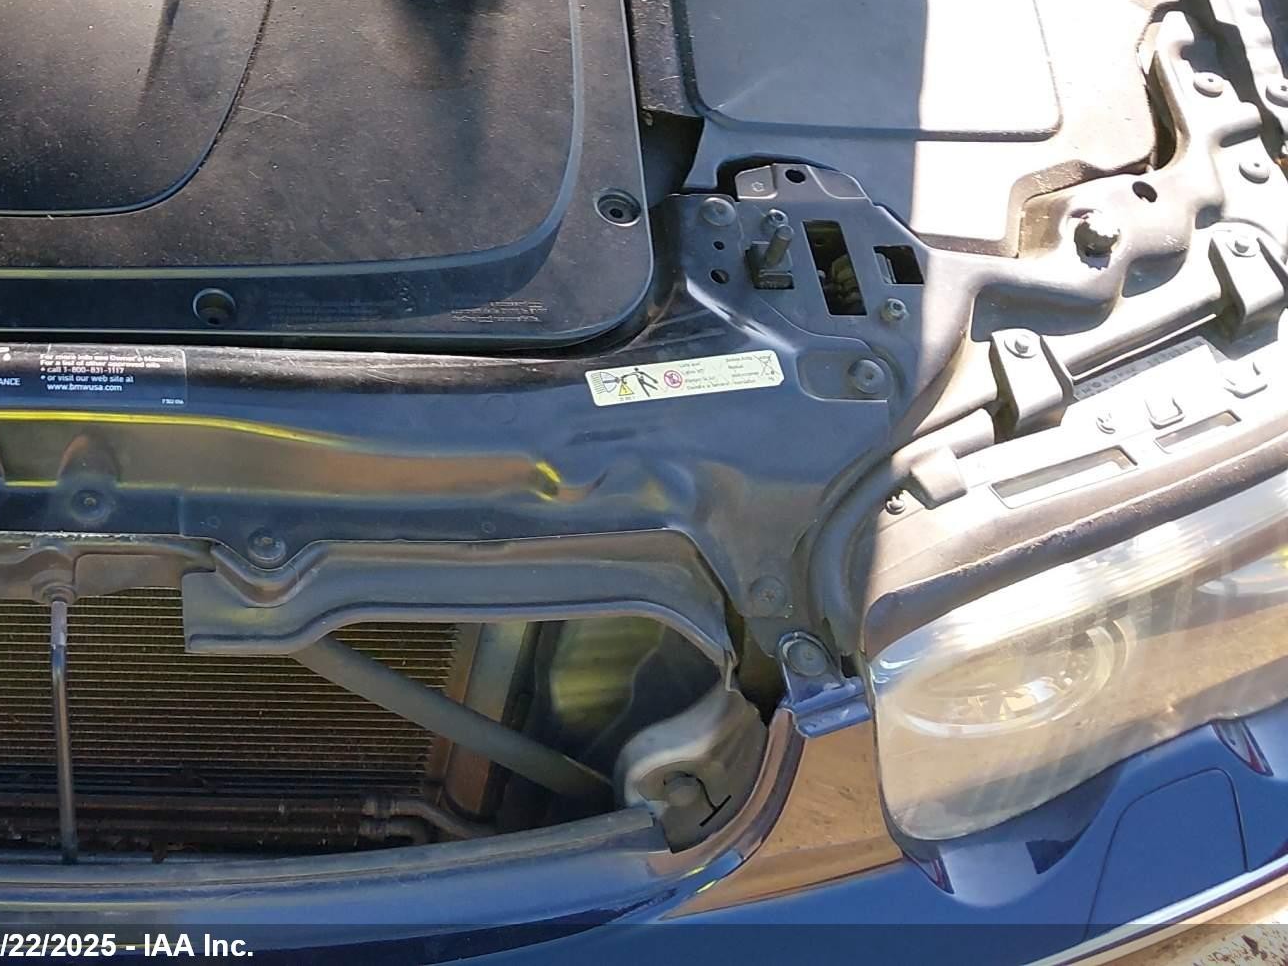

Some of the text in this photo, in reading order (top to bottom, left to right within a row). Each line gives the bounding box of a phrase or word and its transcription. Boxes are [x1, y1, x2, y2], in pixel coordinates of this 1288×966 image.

[57, 374, 74, 382] visit
[91, 374, 108, 382] web
[109, 375, 124, 383] site
[47, 383, 123, 392] www.bmwusa.com
